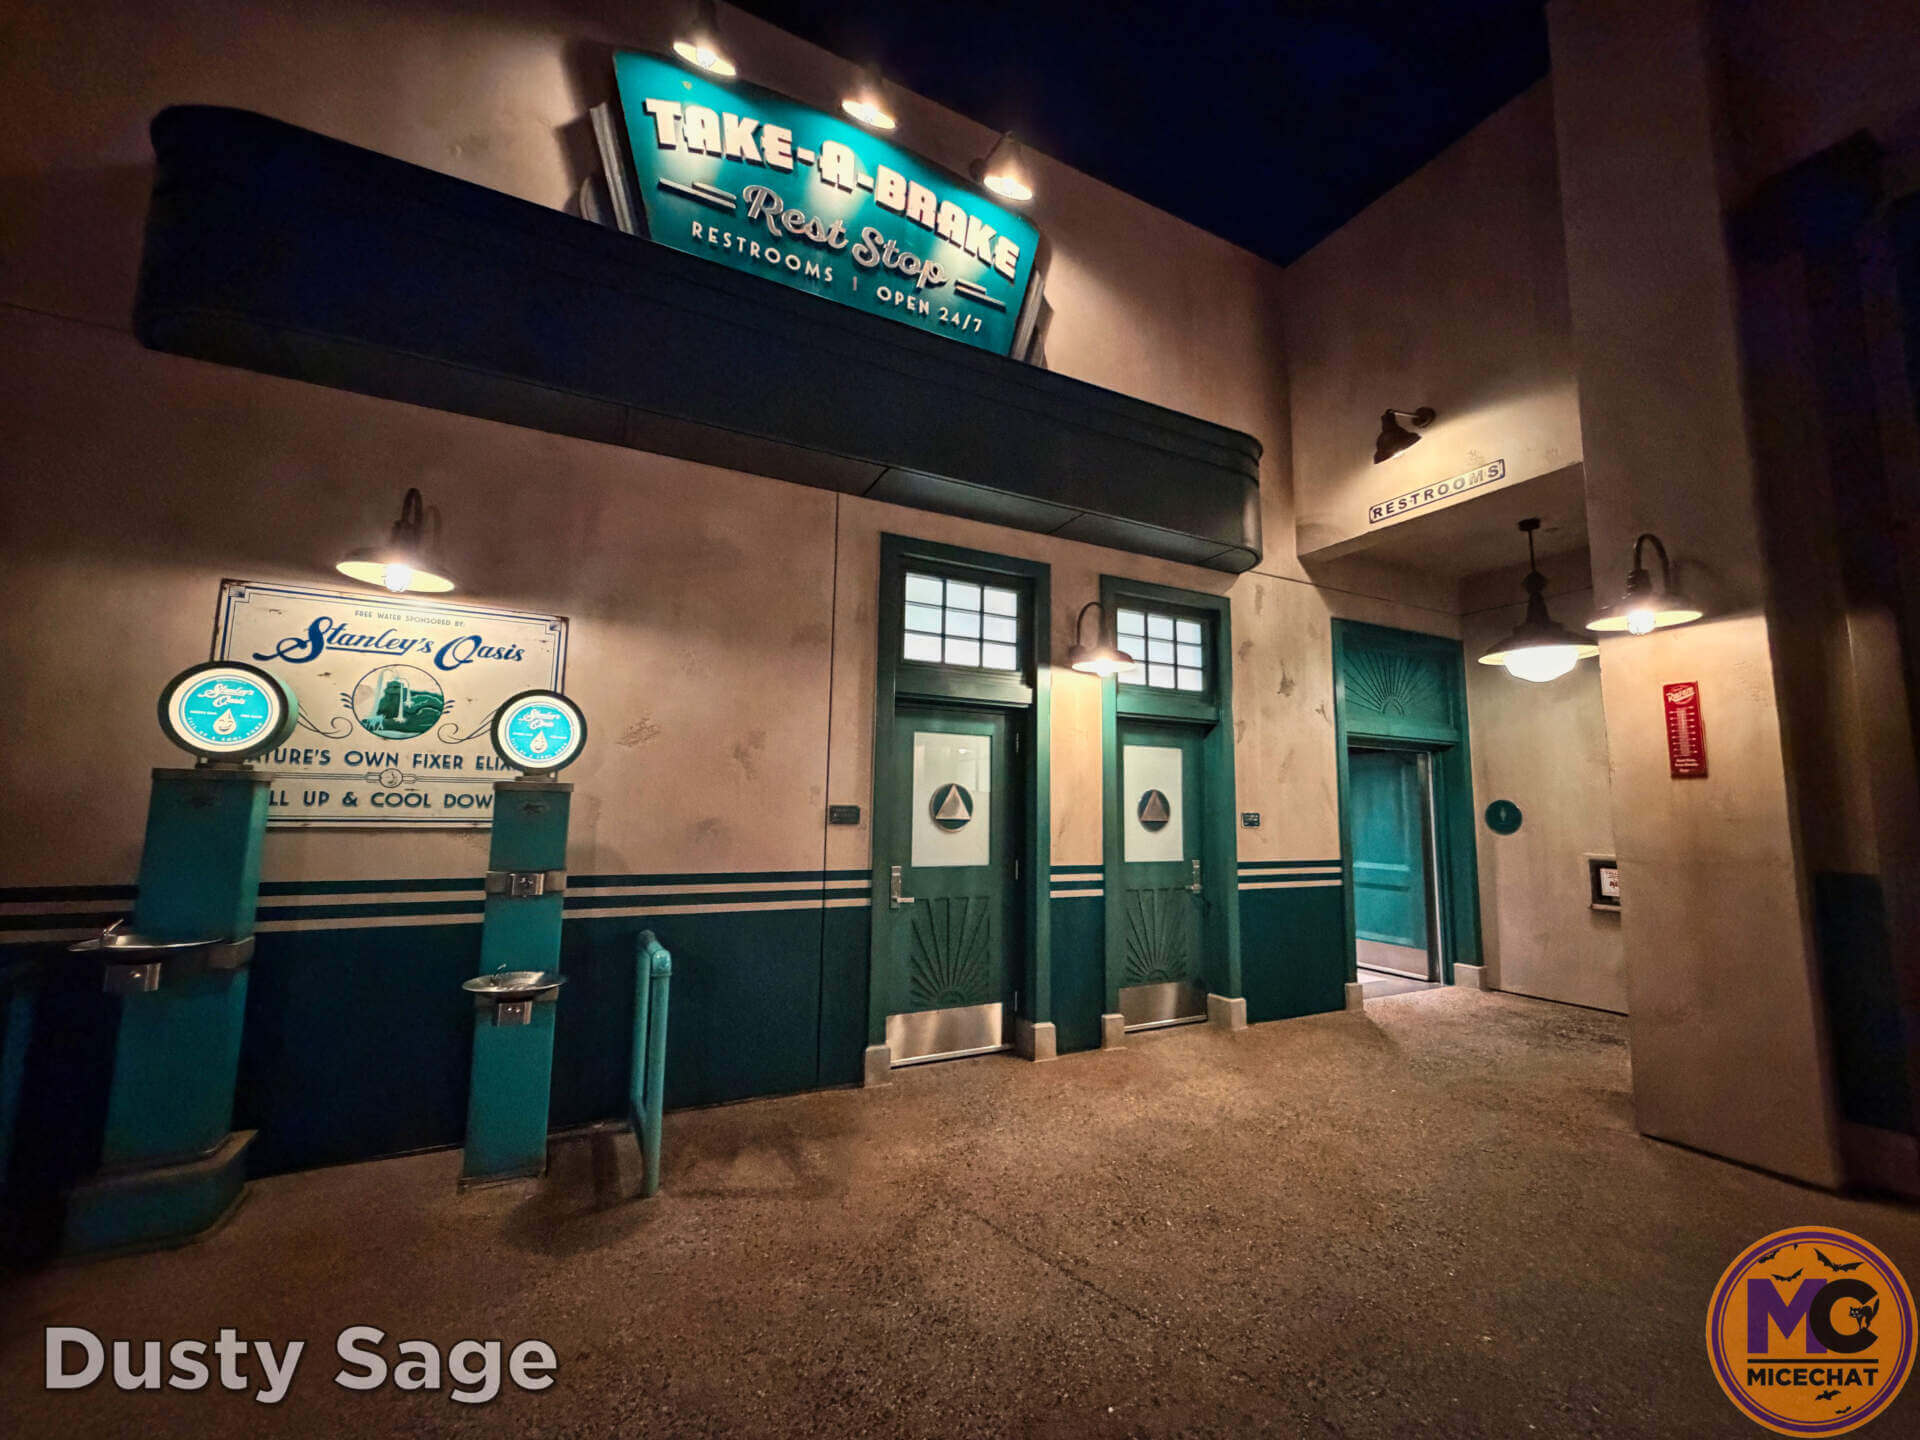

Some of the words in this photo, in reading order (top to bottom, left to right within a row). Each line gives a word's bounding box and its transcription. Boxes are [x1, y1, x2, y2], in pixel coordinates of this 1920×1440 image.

[644, 97, 1020, 284] TAKE-A-BRAKE
[743, 184, 849, 249] Rest
[852, 227, 951, 288] Stop
[692, 221, 833, 282] RESTROOMS
[876, 286, 930, 315] OPEN
[939, 306, 982, 332] 24/7
[1373, 464, 1499, 519] RESTROOMS
[354, 609, 373, 619] FREE
[377, 612, 401, 621] WATER
[252, 616, 433, 664] Stanley's
[433, 635, 525, 671] Oasis
[344, 750, 399, 767] OWN
[412, 753, 463, 769] FIXER
[268, 790, 289, 806] LL
[303, 790, 330, 807] UP
[342, 791, 358, 807] &
[370, 792, 431, 808] COOL
[443, 793, 493, 809] DOW
